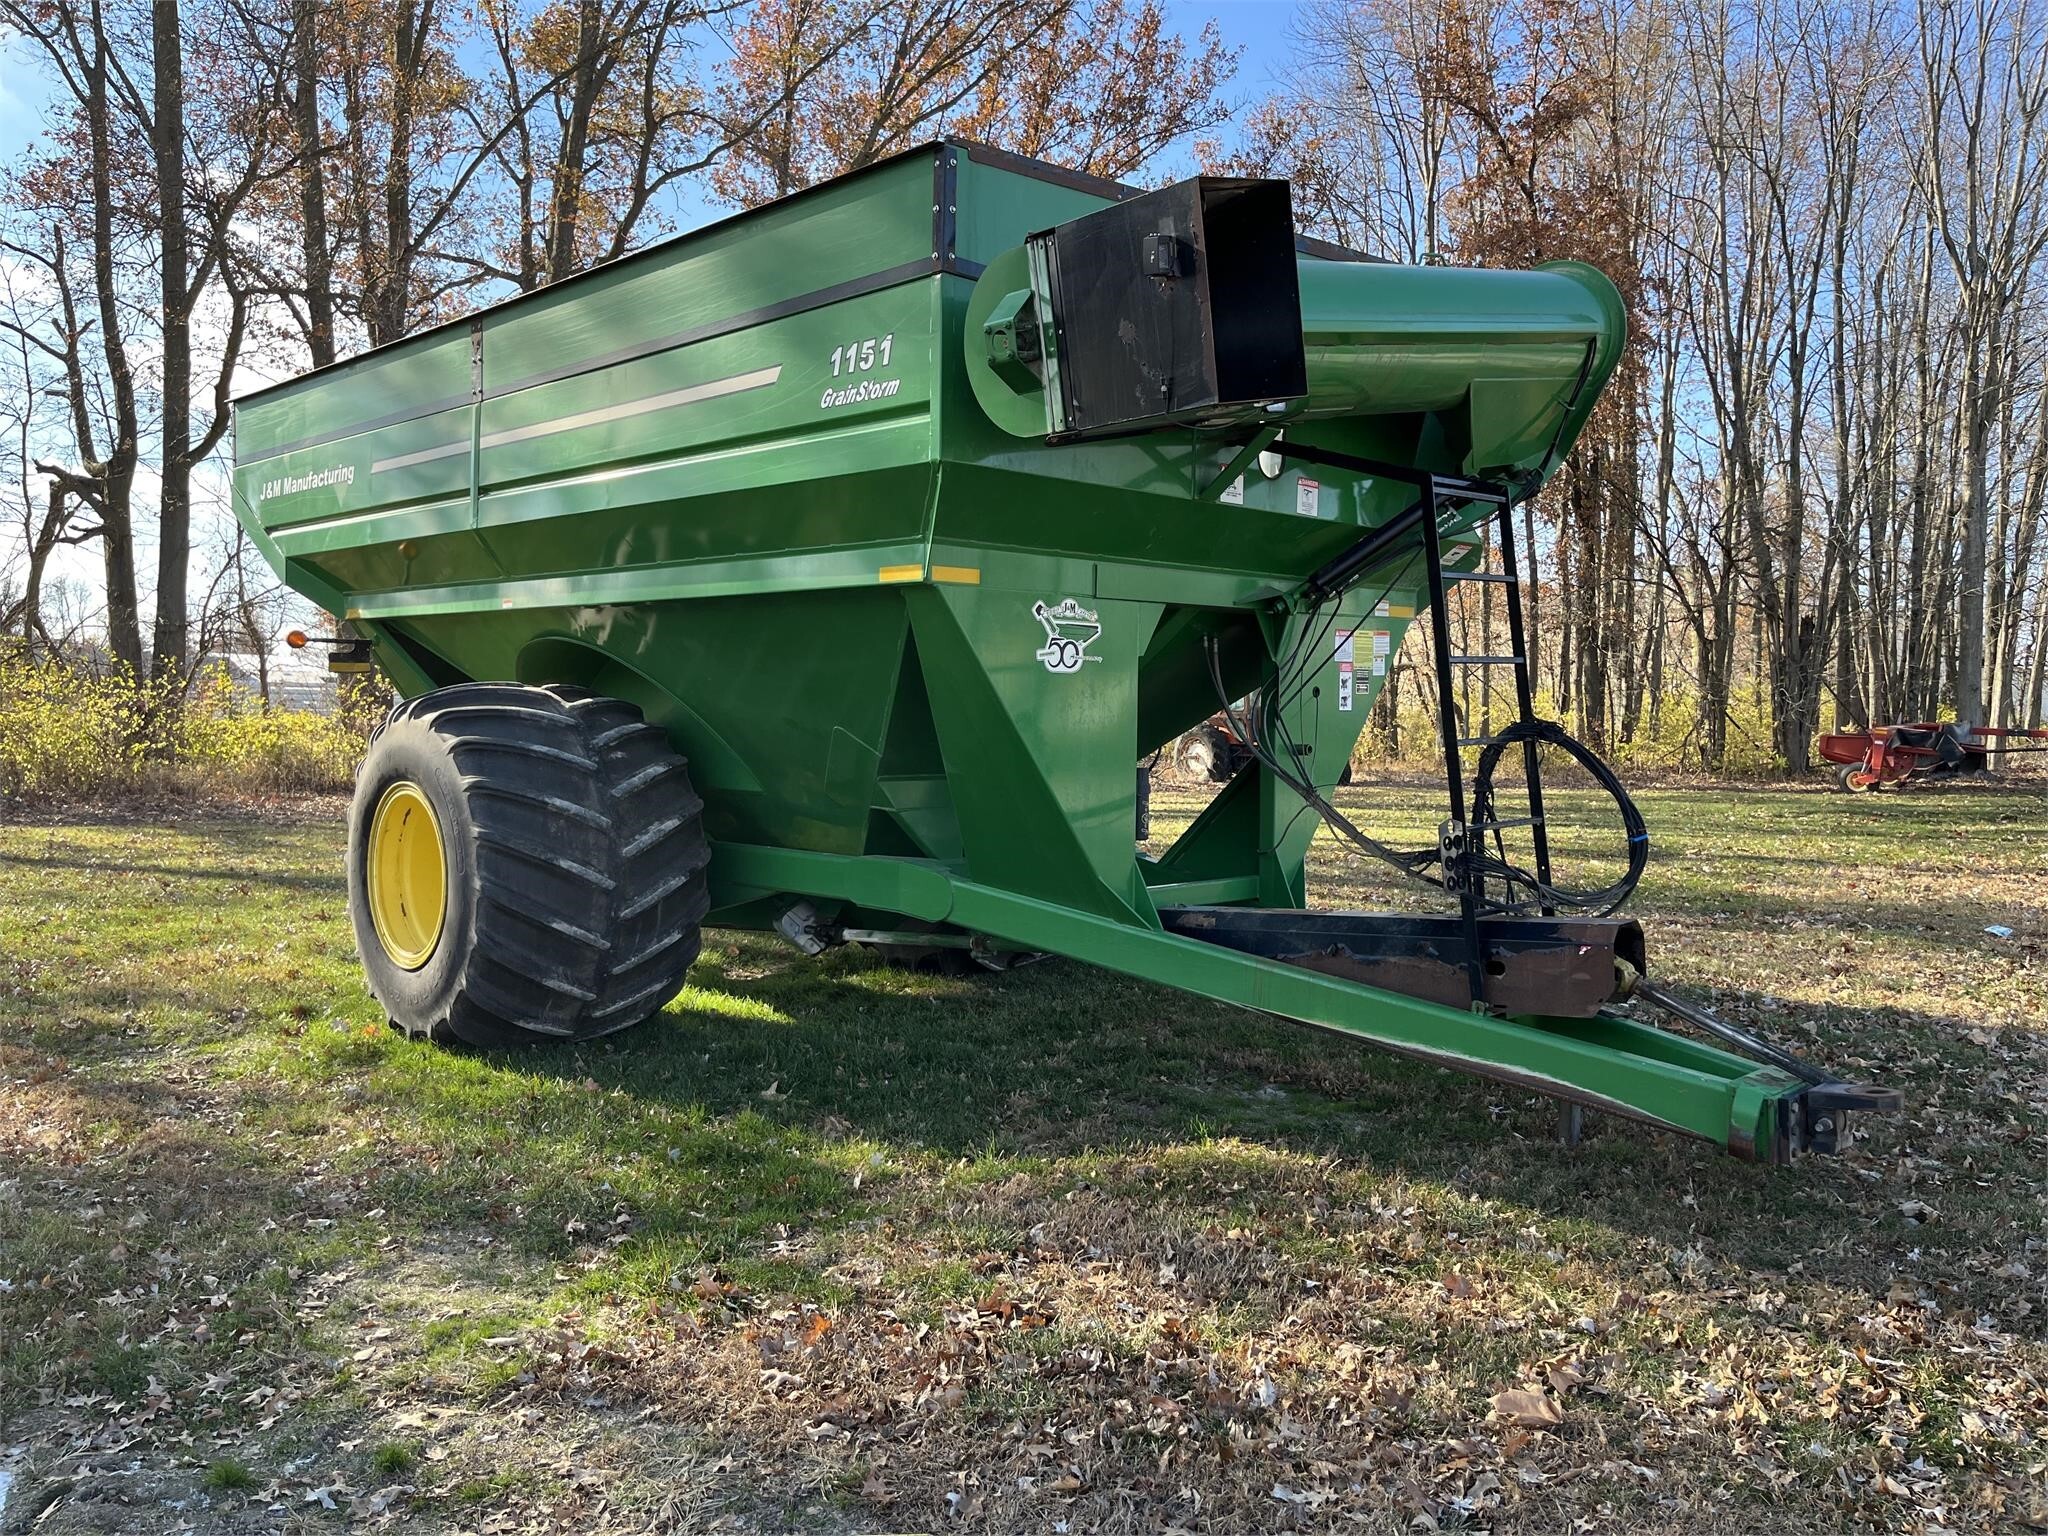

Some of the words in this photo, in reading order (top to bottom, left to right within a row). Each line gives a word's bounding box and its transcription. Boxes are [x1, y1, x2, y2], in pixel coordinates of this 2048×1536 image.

[830, 333, 894, 377] 1151
[820, 379, 900, 409] GrainStorm
[260, 480, 281, 501] J&M
[283, 464, 355, 495] Manufacturing
[1047, 637, 1080, 669] 50
